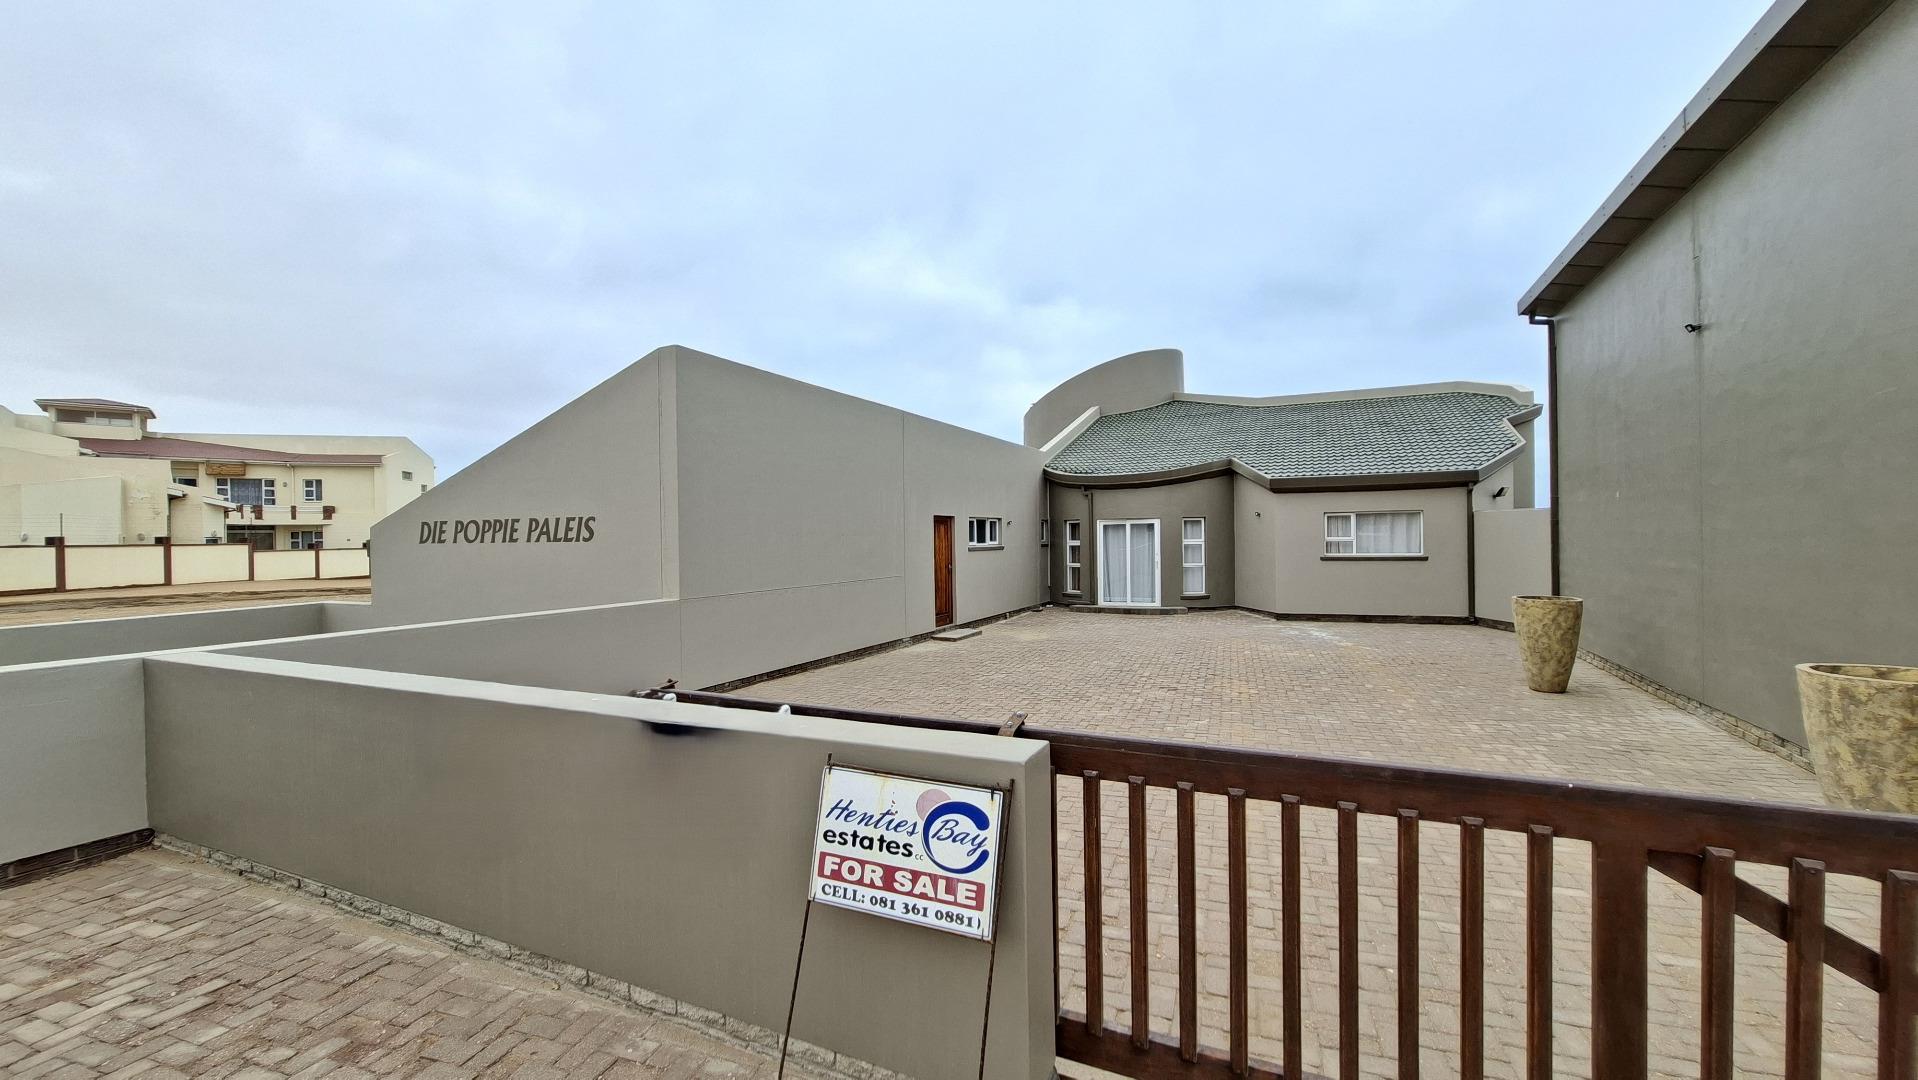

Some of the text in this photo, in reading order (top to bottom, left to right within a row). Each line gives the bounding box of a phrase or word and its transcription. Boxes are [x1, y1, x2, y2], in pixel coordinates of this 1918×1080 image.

[419, 516, 596, 544] DIE POPPIE PALEIS
[822, 828, 914, 858] estates
[825, 798, 989, 857] Henties Bay
[823, 855, 977, 906] FOR SALE
[821, 882, 866, 904] CELL:
[870, 895, 897, 911] 081
[901, 902, 928, 918] 361
